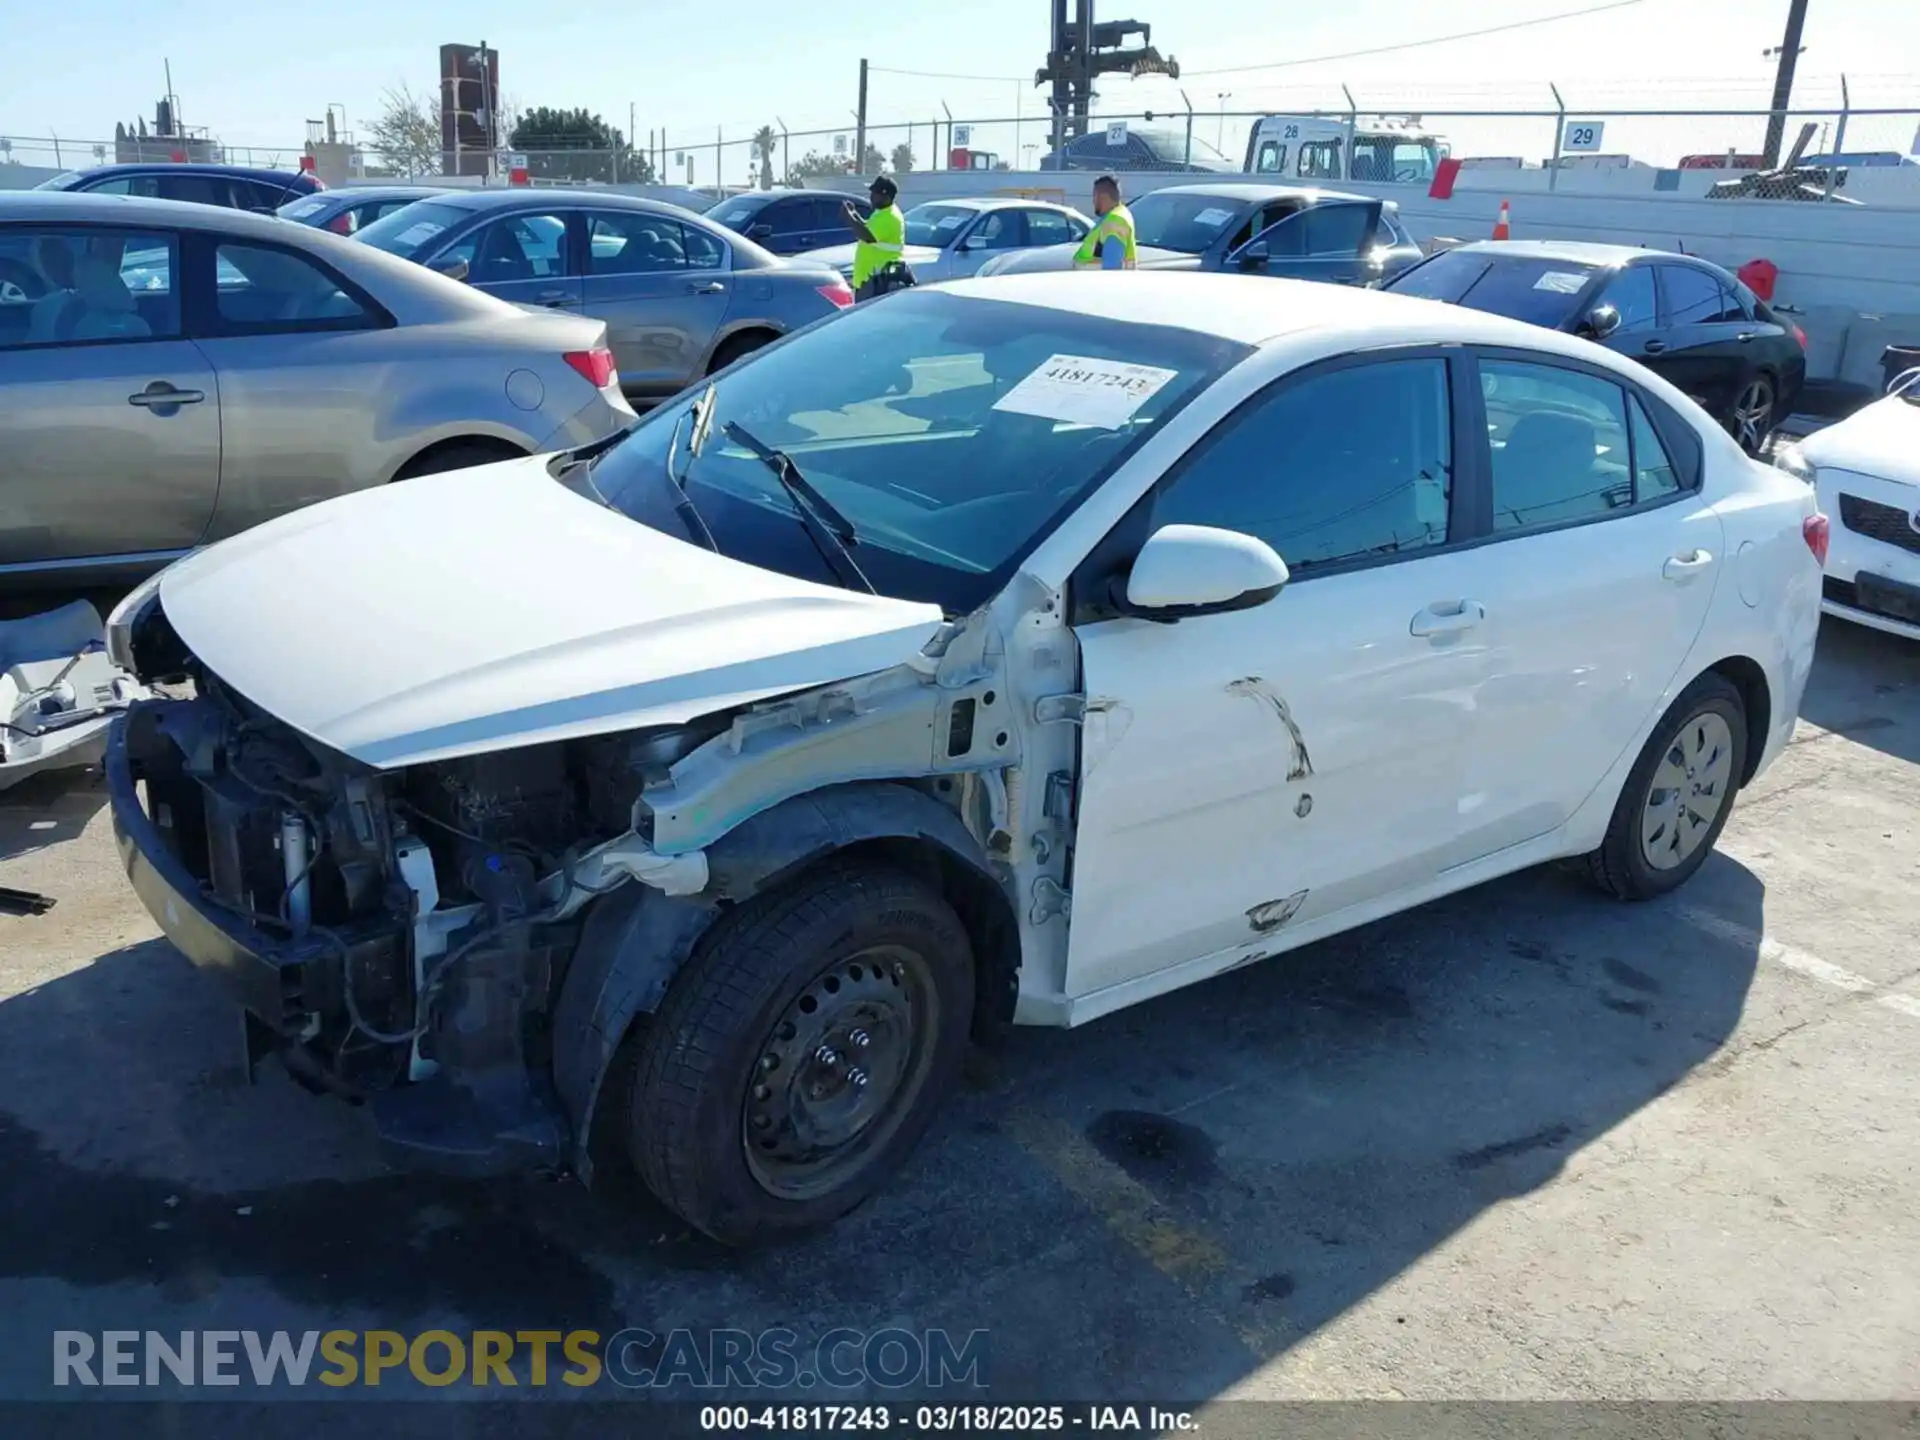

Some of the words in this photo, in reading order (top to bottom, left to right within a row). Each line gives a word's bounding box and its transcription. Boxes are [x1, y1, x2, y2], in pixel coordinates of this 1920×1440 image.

[1284, 124, 1299, 138] 28
[1572, 128, 1594, 145] 29
[1046, 367, 1147, 390] 41817243
